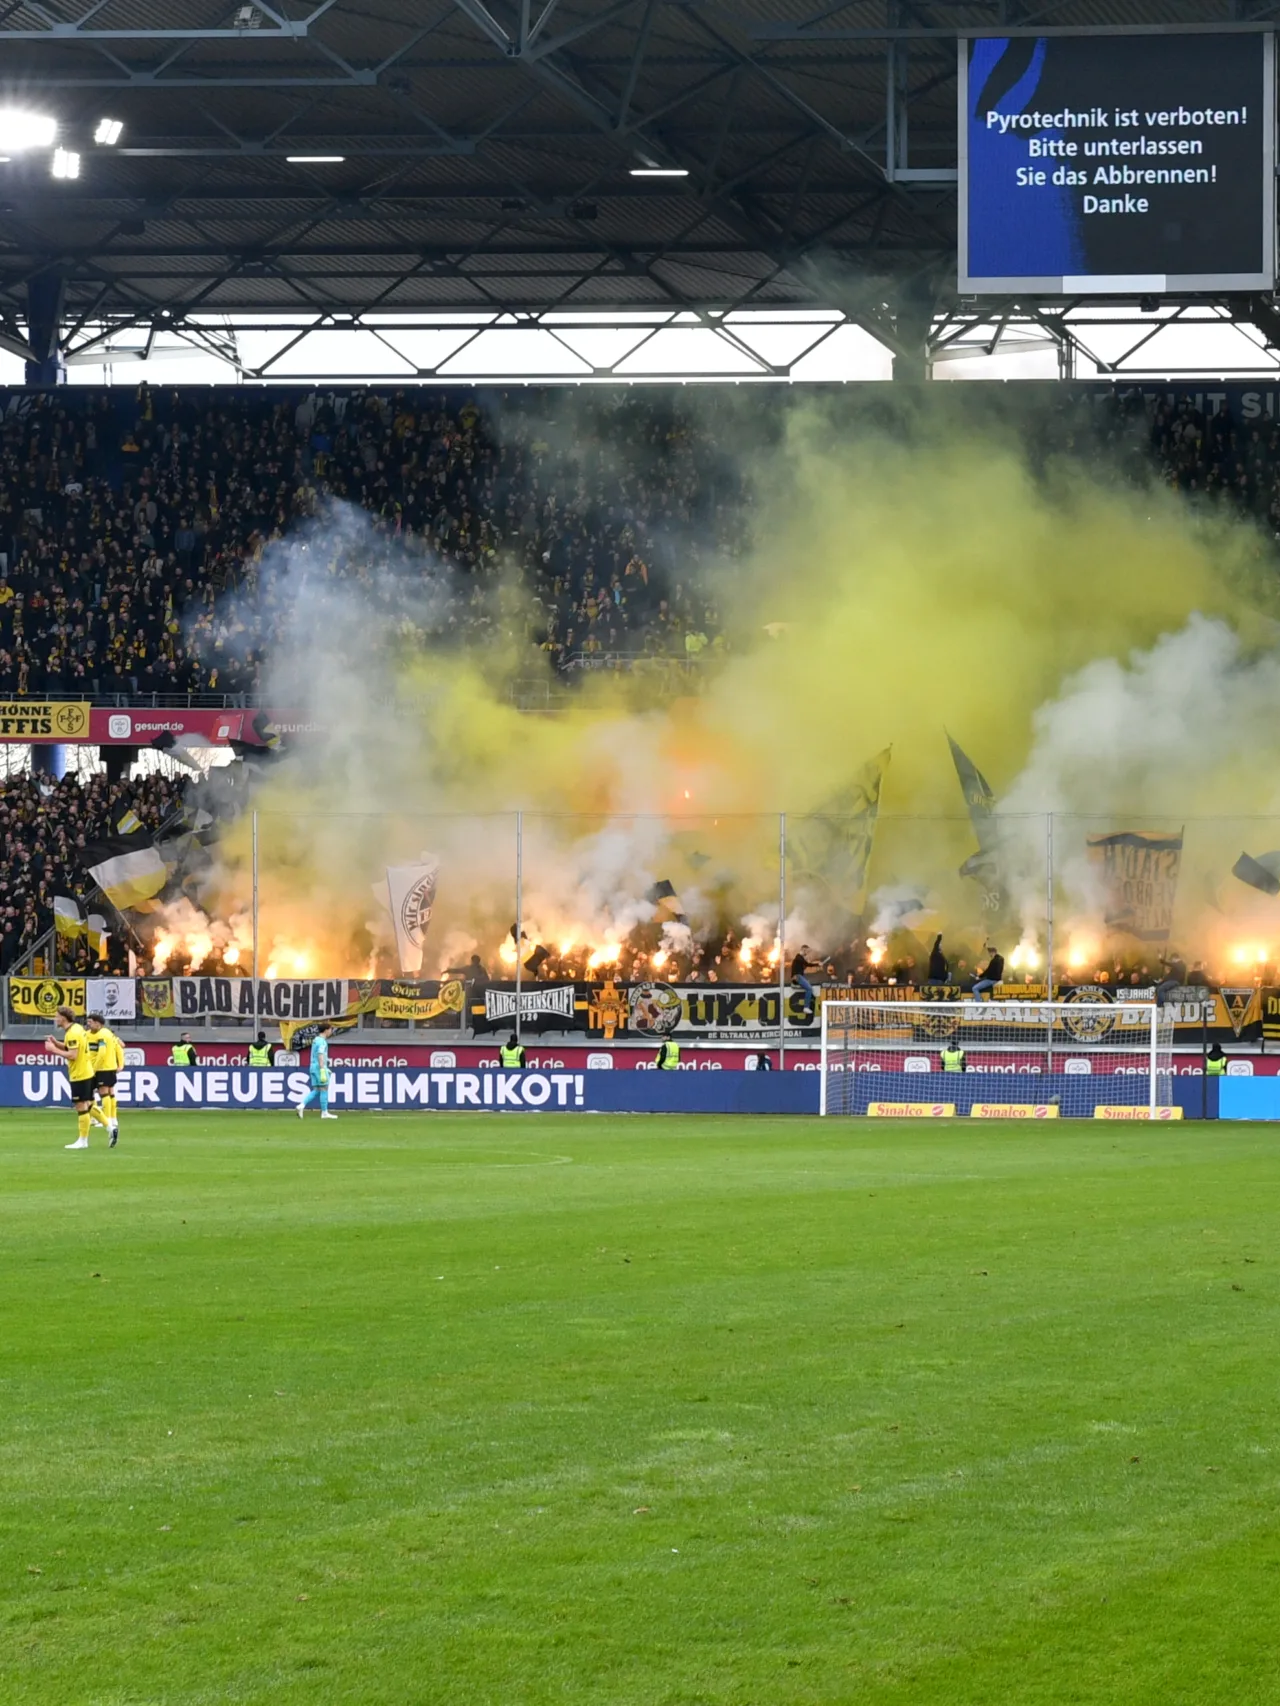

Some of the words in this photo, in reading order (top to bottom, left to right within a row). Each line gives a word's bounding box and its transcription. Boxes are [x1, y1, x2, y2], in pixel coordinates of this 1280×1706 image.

[986, 107, 1108, 133] Pyrotechnik
[1114, 109, 1139, 127] ist
[1145, 106, 1248, 126] verboten!
[1028, 137, 1078, 157] Bitte
[1084, 136, 1203, 155] unterlassen
[1016, 167, 1046, 186] Sie
[1052, 166, 1087, 185] das
[1093, 165, 1217, 184] Abbrennen!
[1083, 194, 1149, 214] Danke
[134, 721, 184, 732] gesund.de
[11, 985, 31, 1004] 20
[180, 978, 232, 1013] BAD
[239, 979, 342, 1018] AACHEN
[485, 987, 574, 1019] FAHRGMEINSCHAFT
[23, 1071, 160, 1102] UNER
[175, 1071, 310, 1102] NEUES
[327, 1071, 584, 1105] HEIMTRIKOT!
[876, 1104, 923, 1116] Sinalco
[980, 1105, 1027, 1117] Sinalco
[1103, 1108, 1151, 1119] Sinalco
